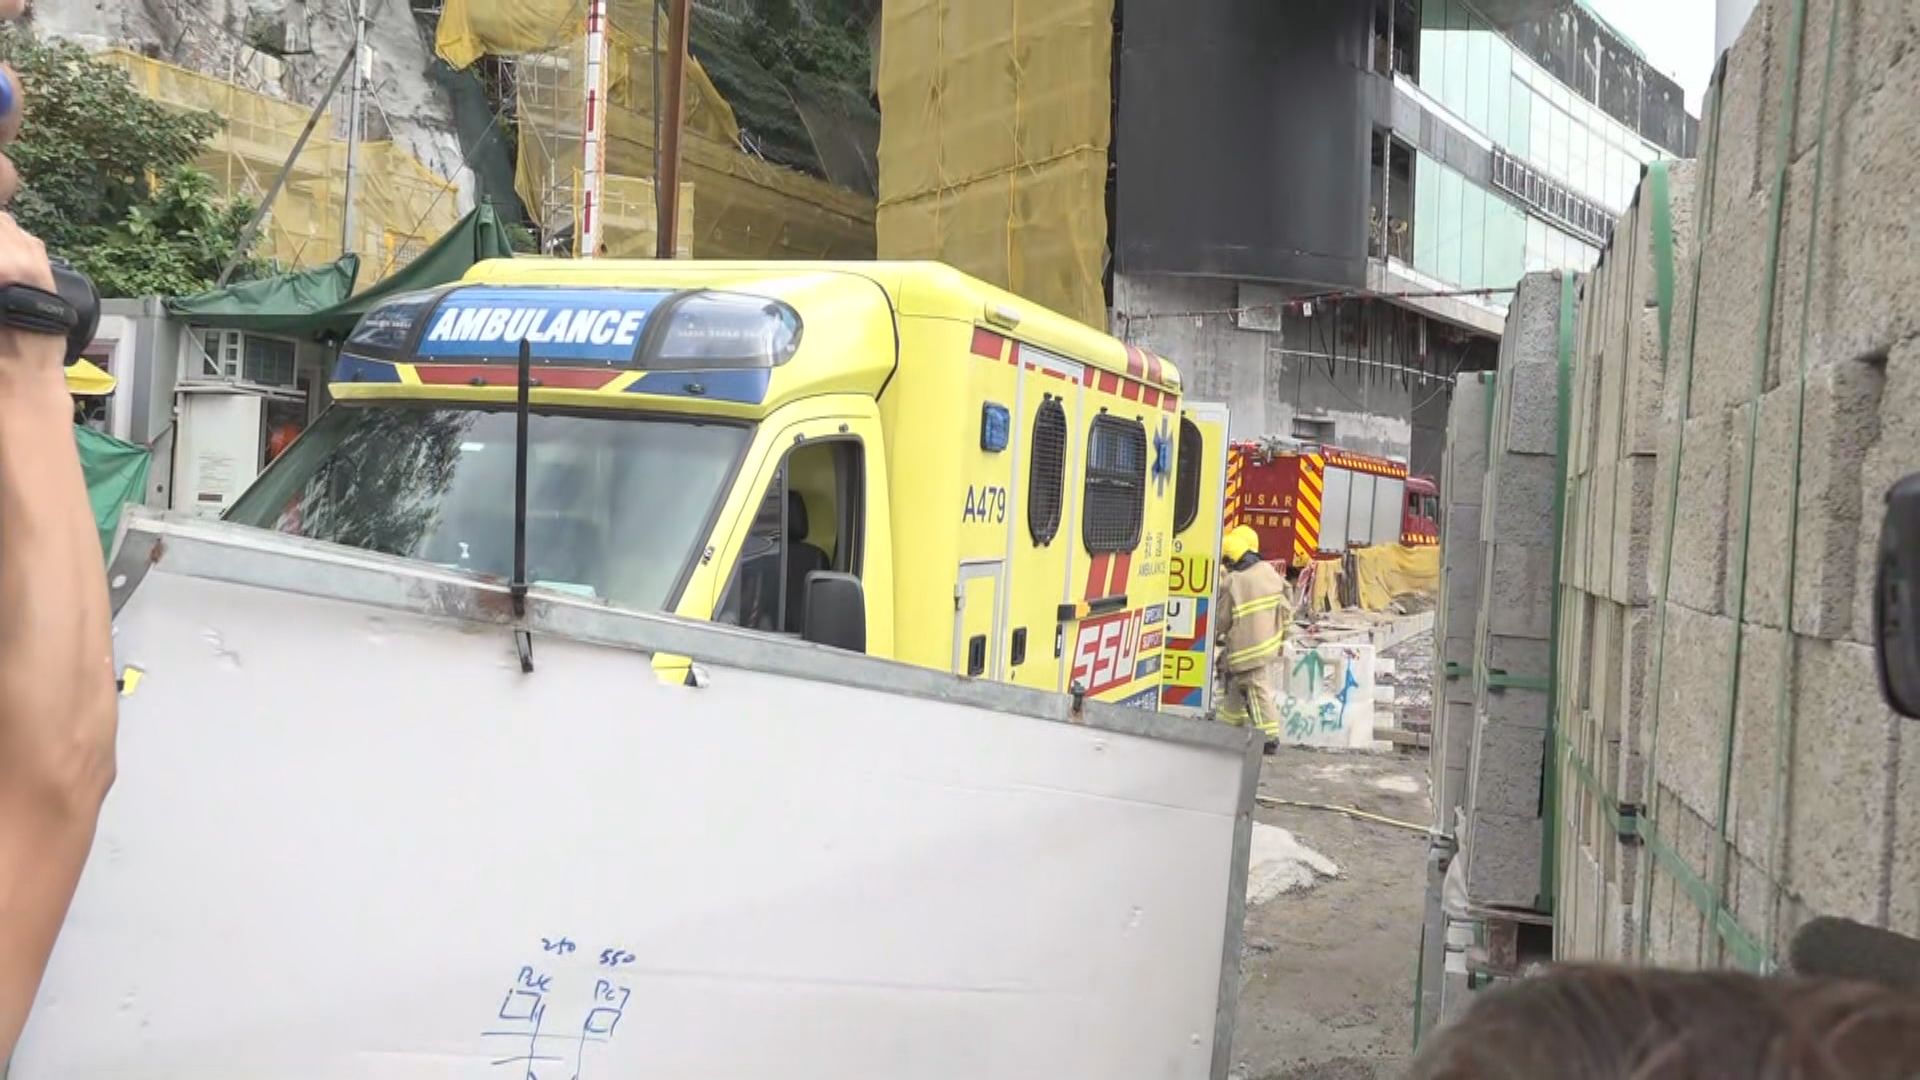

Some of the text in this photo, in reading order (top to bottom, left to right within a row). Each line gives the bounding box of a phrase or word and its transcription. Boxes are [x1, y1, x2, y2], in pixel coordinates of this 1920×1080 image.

[427, 307, 646, 345] AMBULANCE
[963, 485, 1006, 523] A479
[1244, 493, 1293, 507] USAR
[1172, 540, 1182, 552] 9
[1071, 616, 1140, 690] SSU
[599, 948, 636, 966] 550
